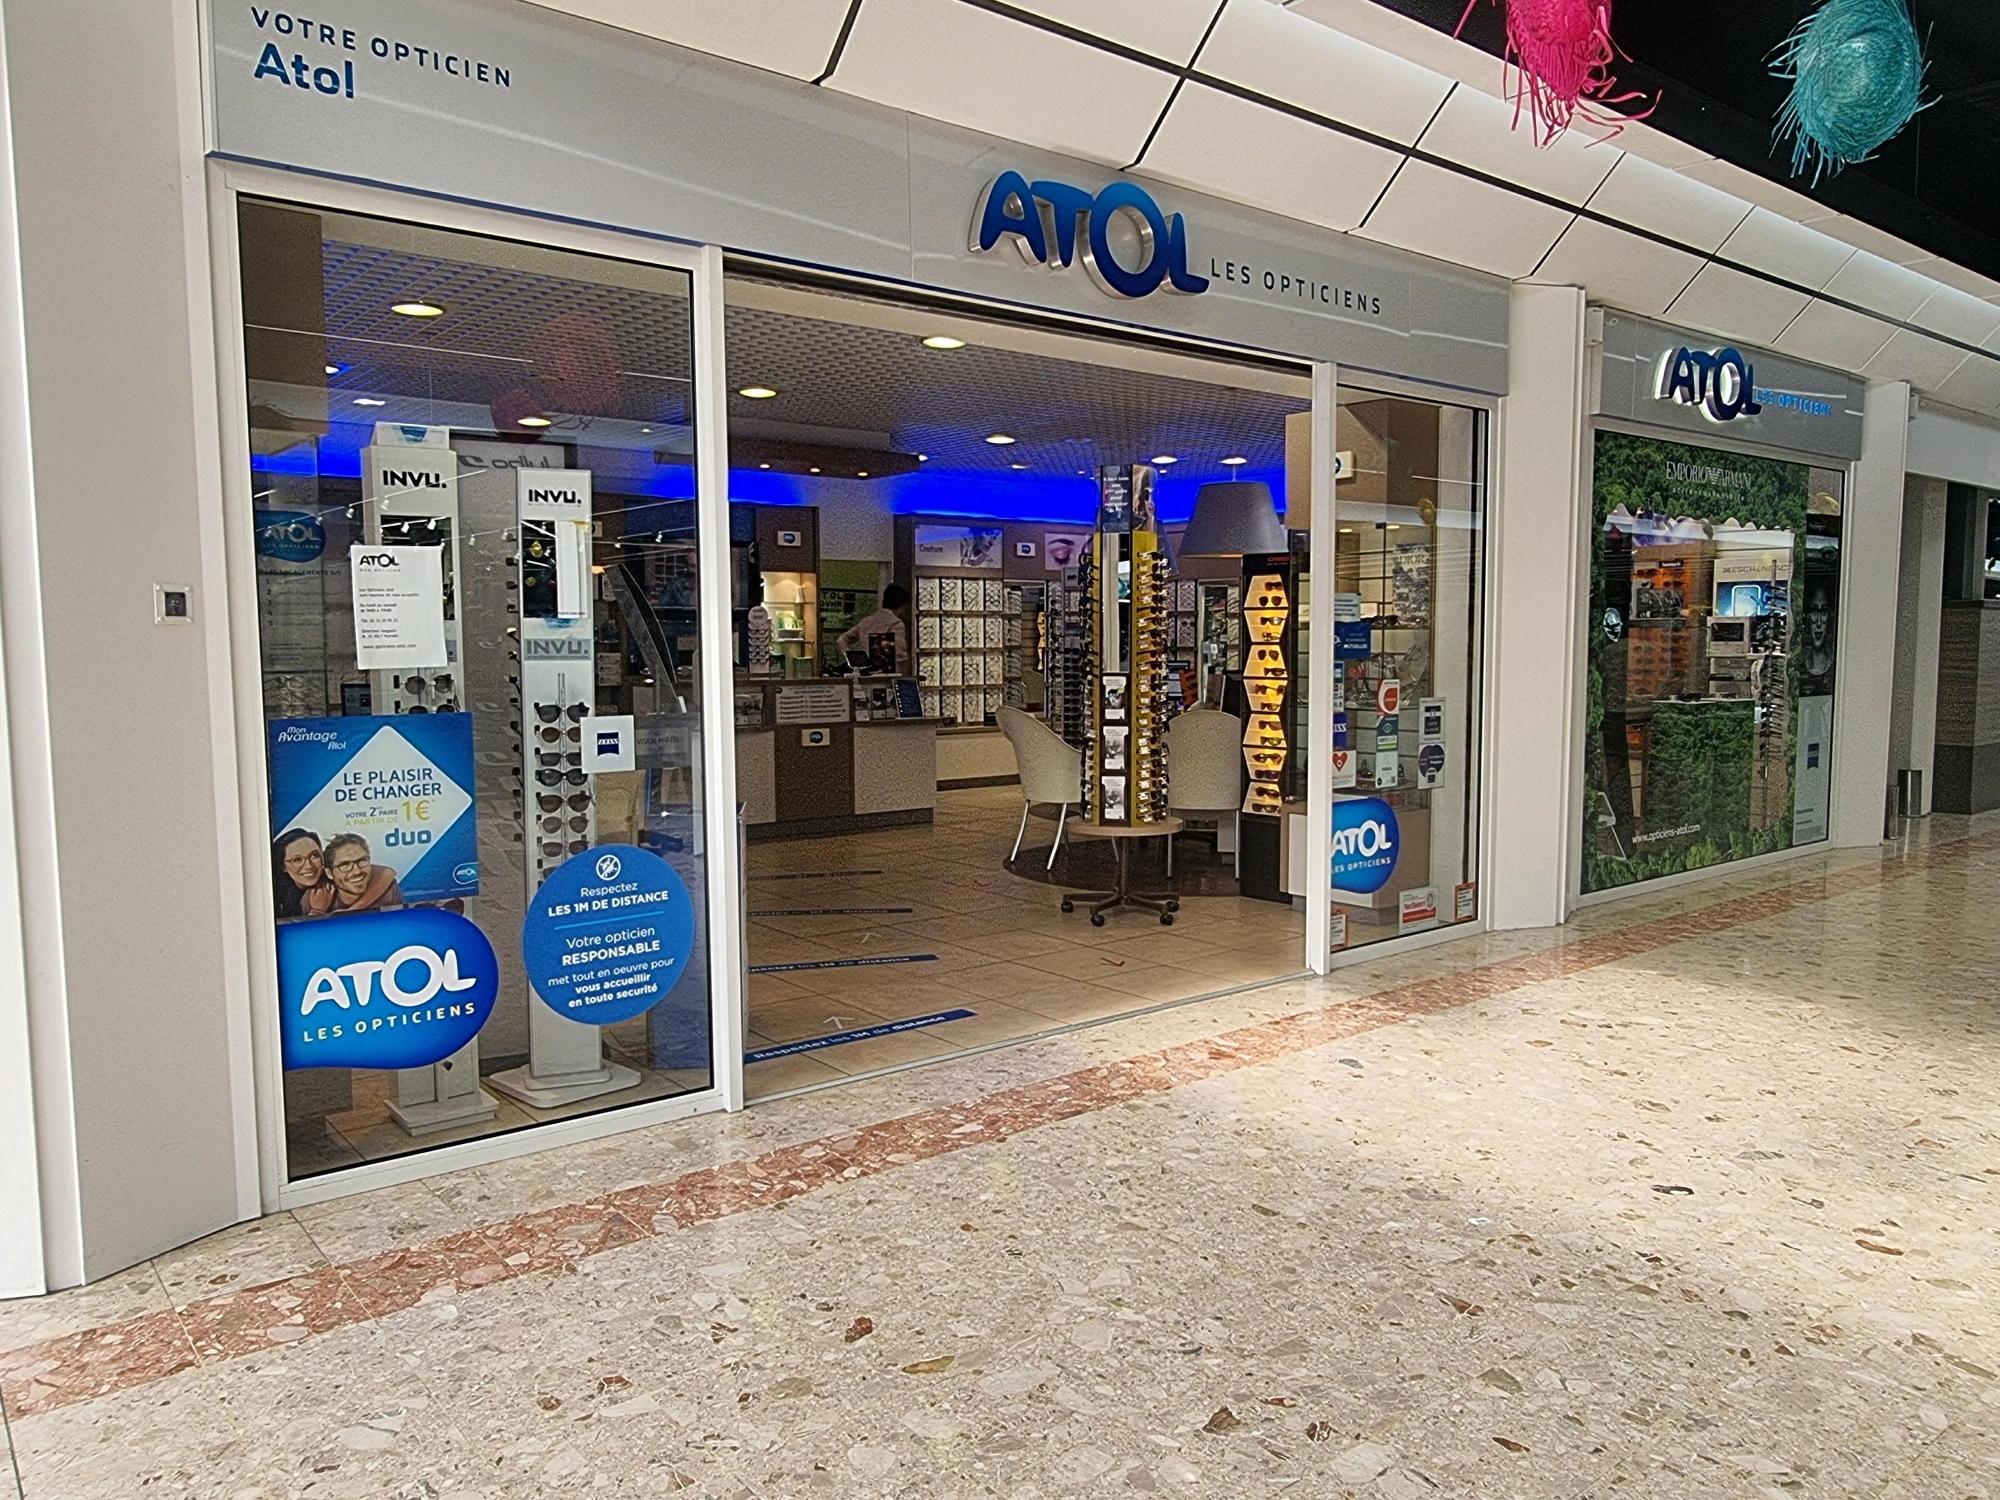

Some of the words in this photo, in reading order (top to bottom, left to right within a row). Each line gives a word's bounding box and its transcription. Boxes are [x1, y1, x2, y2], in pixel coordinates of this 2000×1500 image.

[251, 6, 356, 50] VOTRE
[371, 37, 511, 87] OPTICIEN
[254, 42, 354, 98] Atol
[973, 170, 1209, 298] ATOL
[1211, 258, 1250, 285] LES
[1264, 271, 1380, 315] OPTICIENS
[1664, 347, 1761, 421] ATOL
[1666, 461, 1708, 483] EMPORIO
[360, 554, 400, 567] ATOL
[278, 731, 338, 743] Avantage
[287, 726, 307, 734] Mon
[344, 772, 362, 786] LE
[369, 768, 432, 784] PLAISIR
[335, 788, 357, 802] DE
[362, 783, 442, 800] CHANGER
[353, 817, 385, 826] PARTIR
[388, 816, 399, 824] DE
[385, 828, 431, 847] duo
[1332, 820, 1392, 858] ATOL
[1347, 857, 1391, 872] OPTICIENS
[581, 883, 638, 898] Respectez
[548, 904, 571, 917] LES
[574, 902, 589, 913] 1M
[592, 899, 608, 910] DE
[612, 891, 669, 907] DISTANCE
[566, 934, 601, 949] Votre
[605, 927, 656, 945] opticien
[562, 940, 661, 966] RESPONSABLE
[301, 945, 476, 1016] ATOL
[548, 974, 569, 987] met
[572, 972, 594, 983] tout
[597, 969, 611, 978] en
[614, 962, 649, 975] oeuvre
[651, 958, 675, 971] pour
[575, 983, 601, 994] vous
[603, 973, 651, 989] accueillir
[568, 999, 582, 1008] en
[585, 992, 614, 1006] toute
[303, 1025, 343, 1042] LES
[355, 1003, 475, 1033] OPTICIENS
